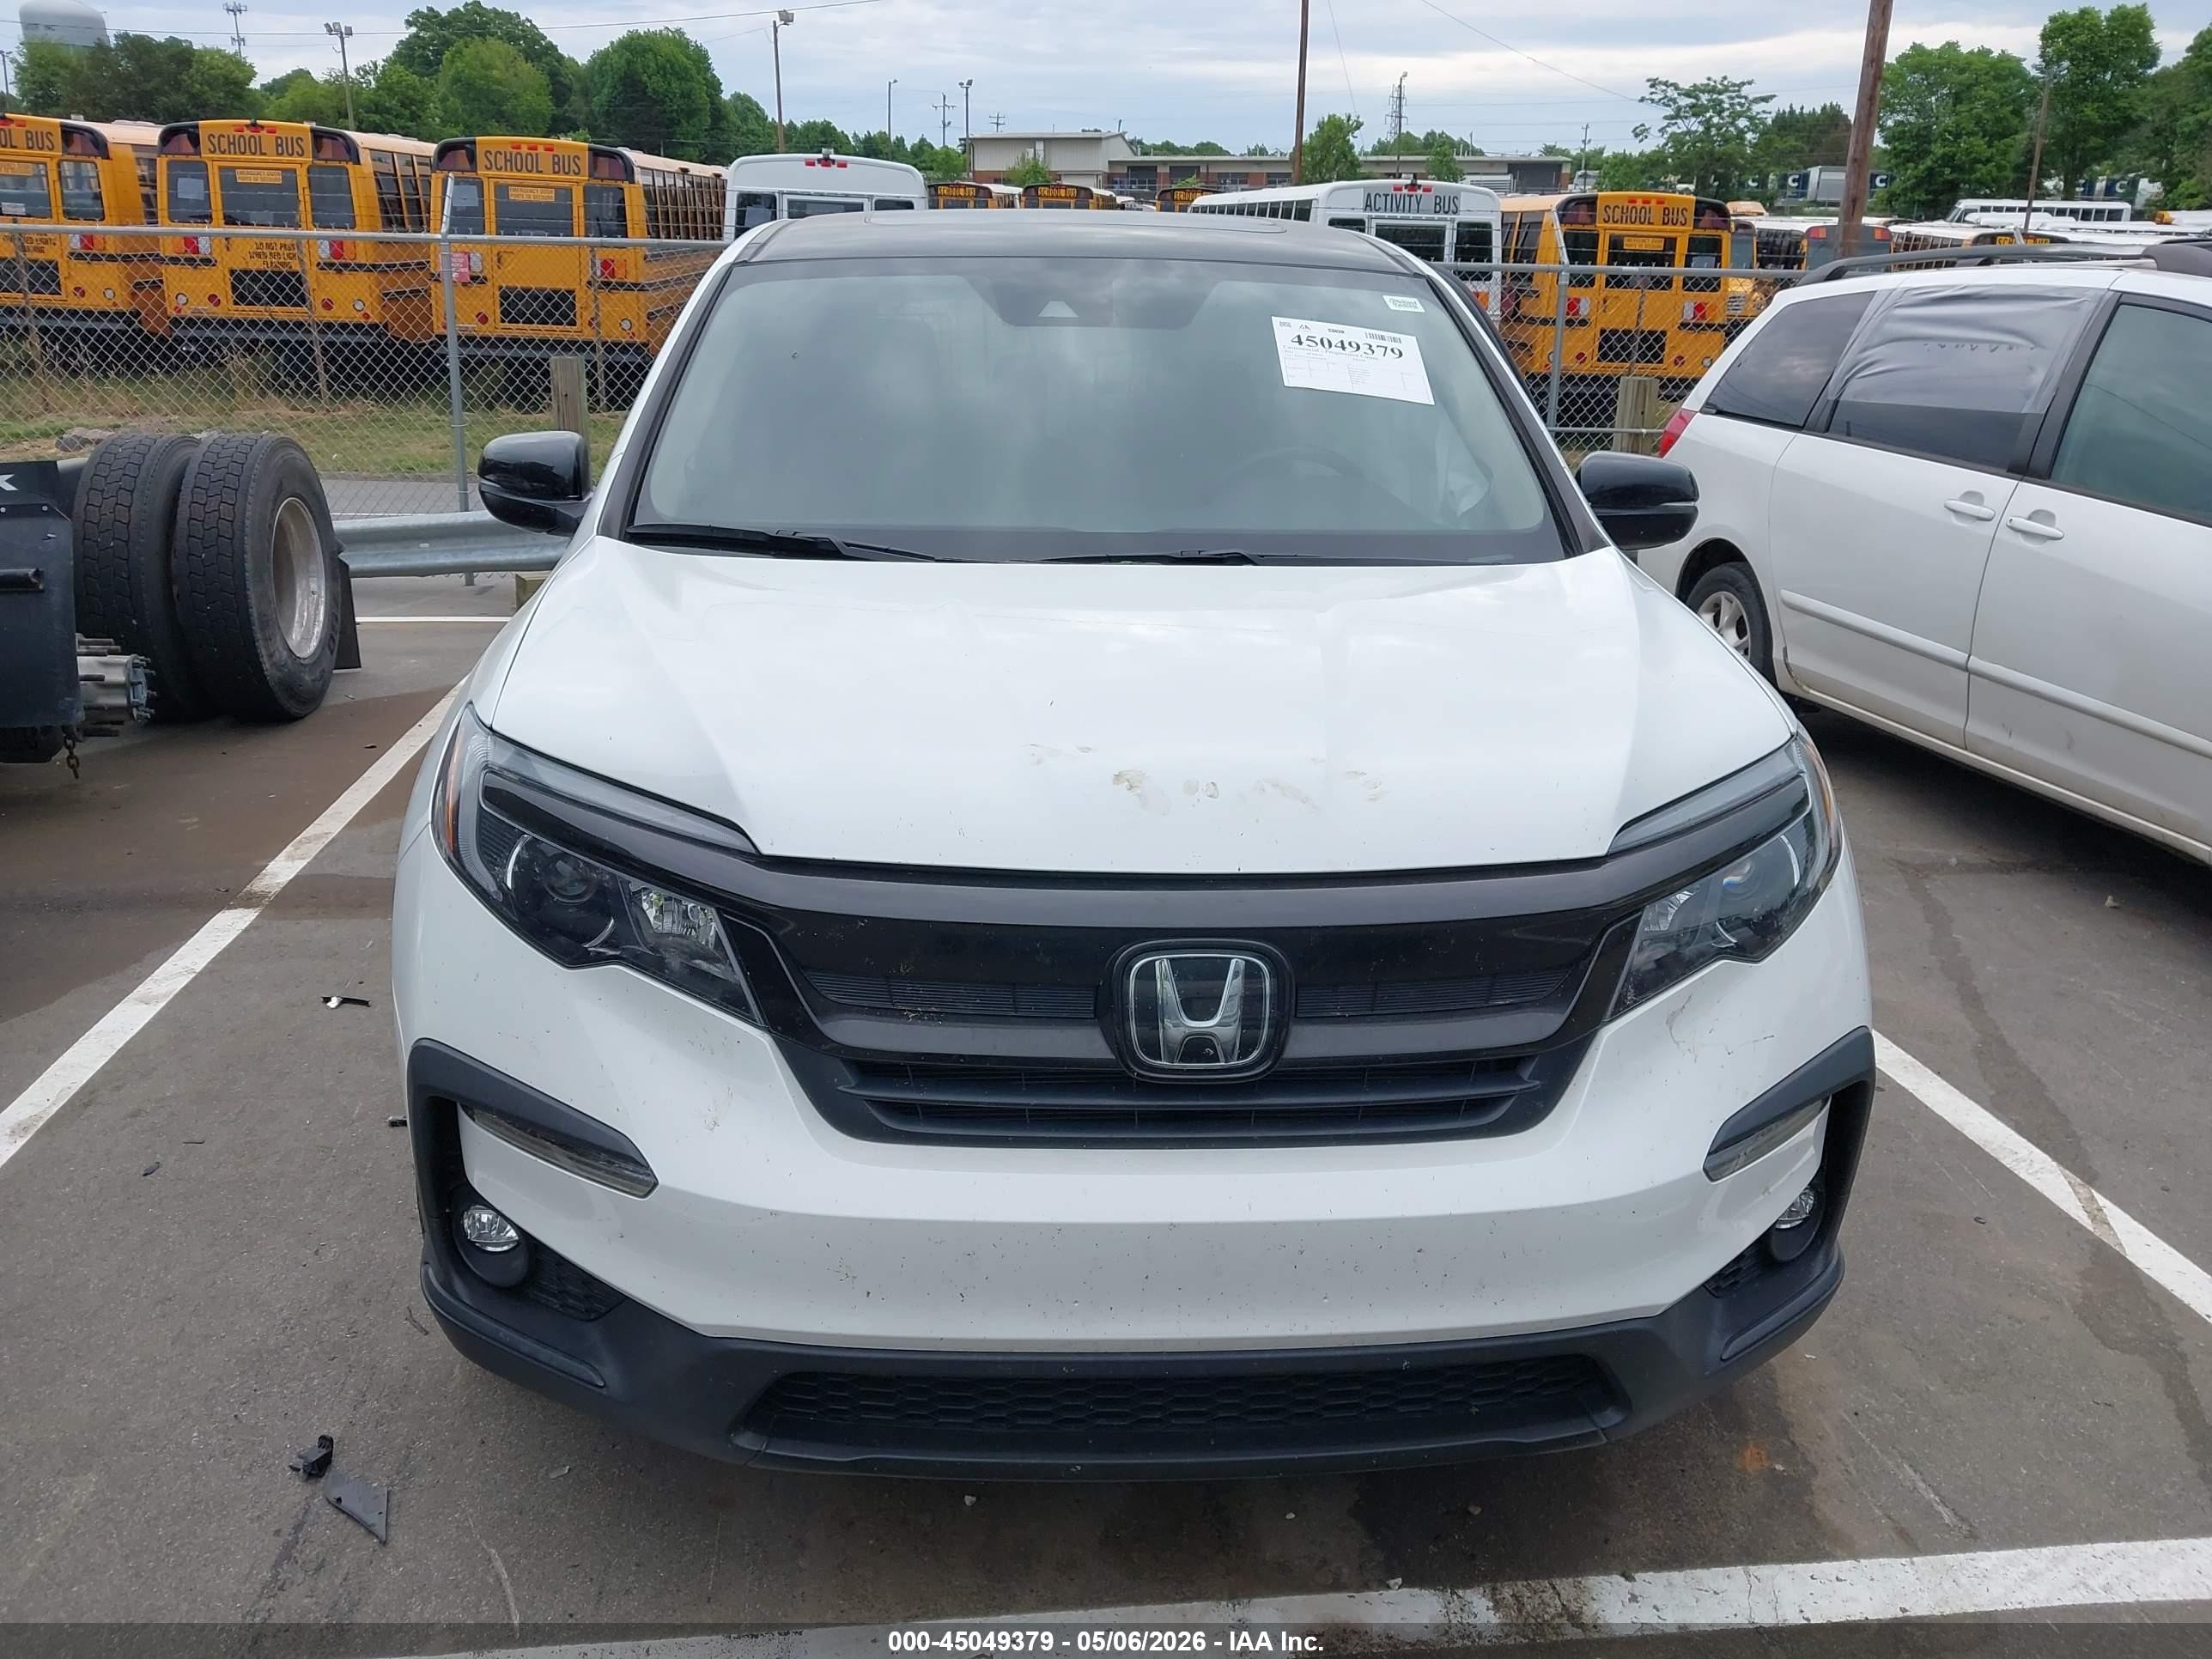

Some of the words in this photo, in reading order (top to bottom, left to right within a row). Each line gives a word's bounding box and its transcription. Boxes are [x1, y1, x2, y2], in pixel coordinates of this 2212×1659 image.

[26, 131, 55, 150] BUS
[208, 134, 267, 155] SCHOOL
[275, 136, 305, 156] BUS
[484, 150, 543, 173] SCHOOL
[552, 154, 580, 175] BUS
[1038, 187, 1061, 197] SCHOOL
[1364, 192, 1423, 213] ACTIVITY
[1434, 195, 1459, 215] BUS
[1603, 204, 1654, 225] SCHOOL
[1662, 206, 1687, 226] BUS
[1291, 333, 1404, 359] 45049379
